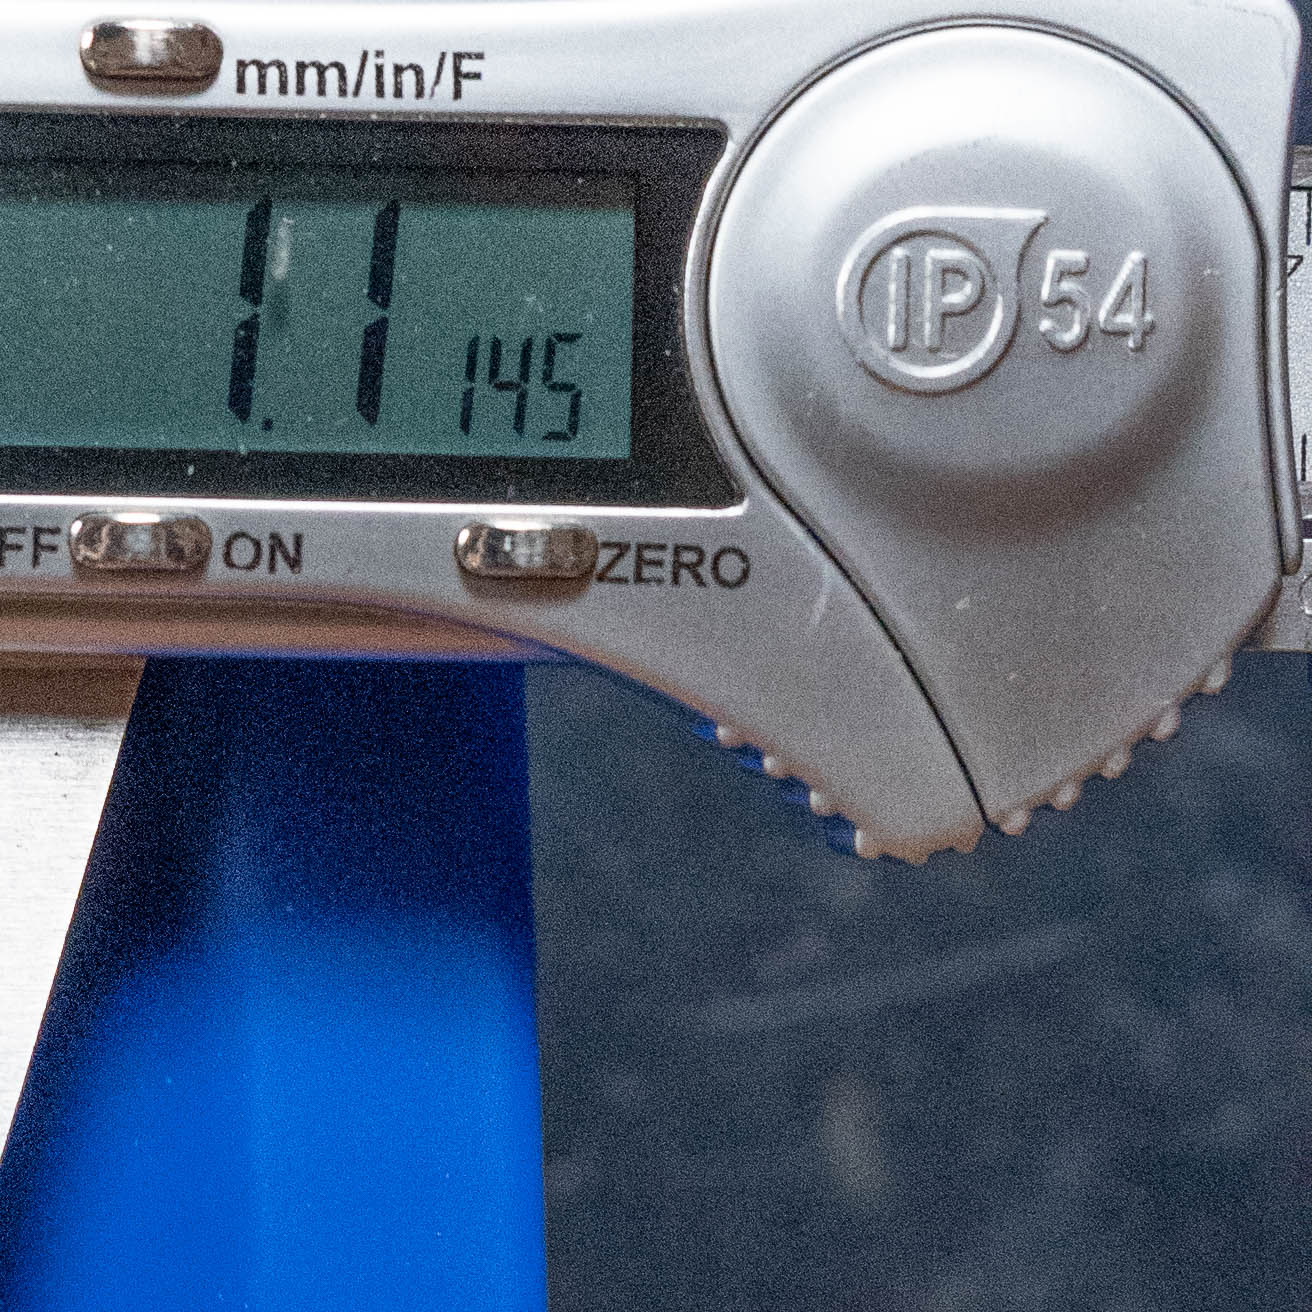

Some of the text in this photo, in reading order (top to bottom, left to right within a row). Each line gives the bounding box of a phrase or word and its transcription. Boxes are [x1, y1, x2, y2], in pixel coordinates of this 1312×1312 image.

[235, 49, 485, 101] mm/in/F
[222, 532, 303, 575] ON
[594, 541, 751, 589] ZERO
